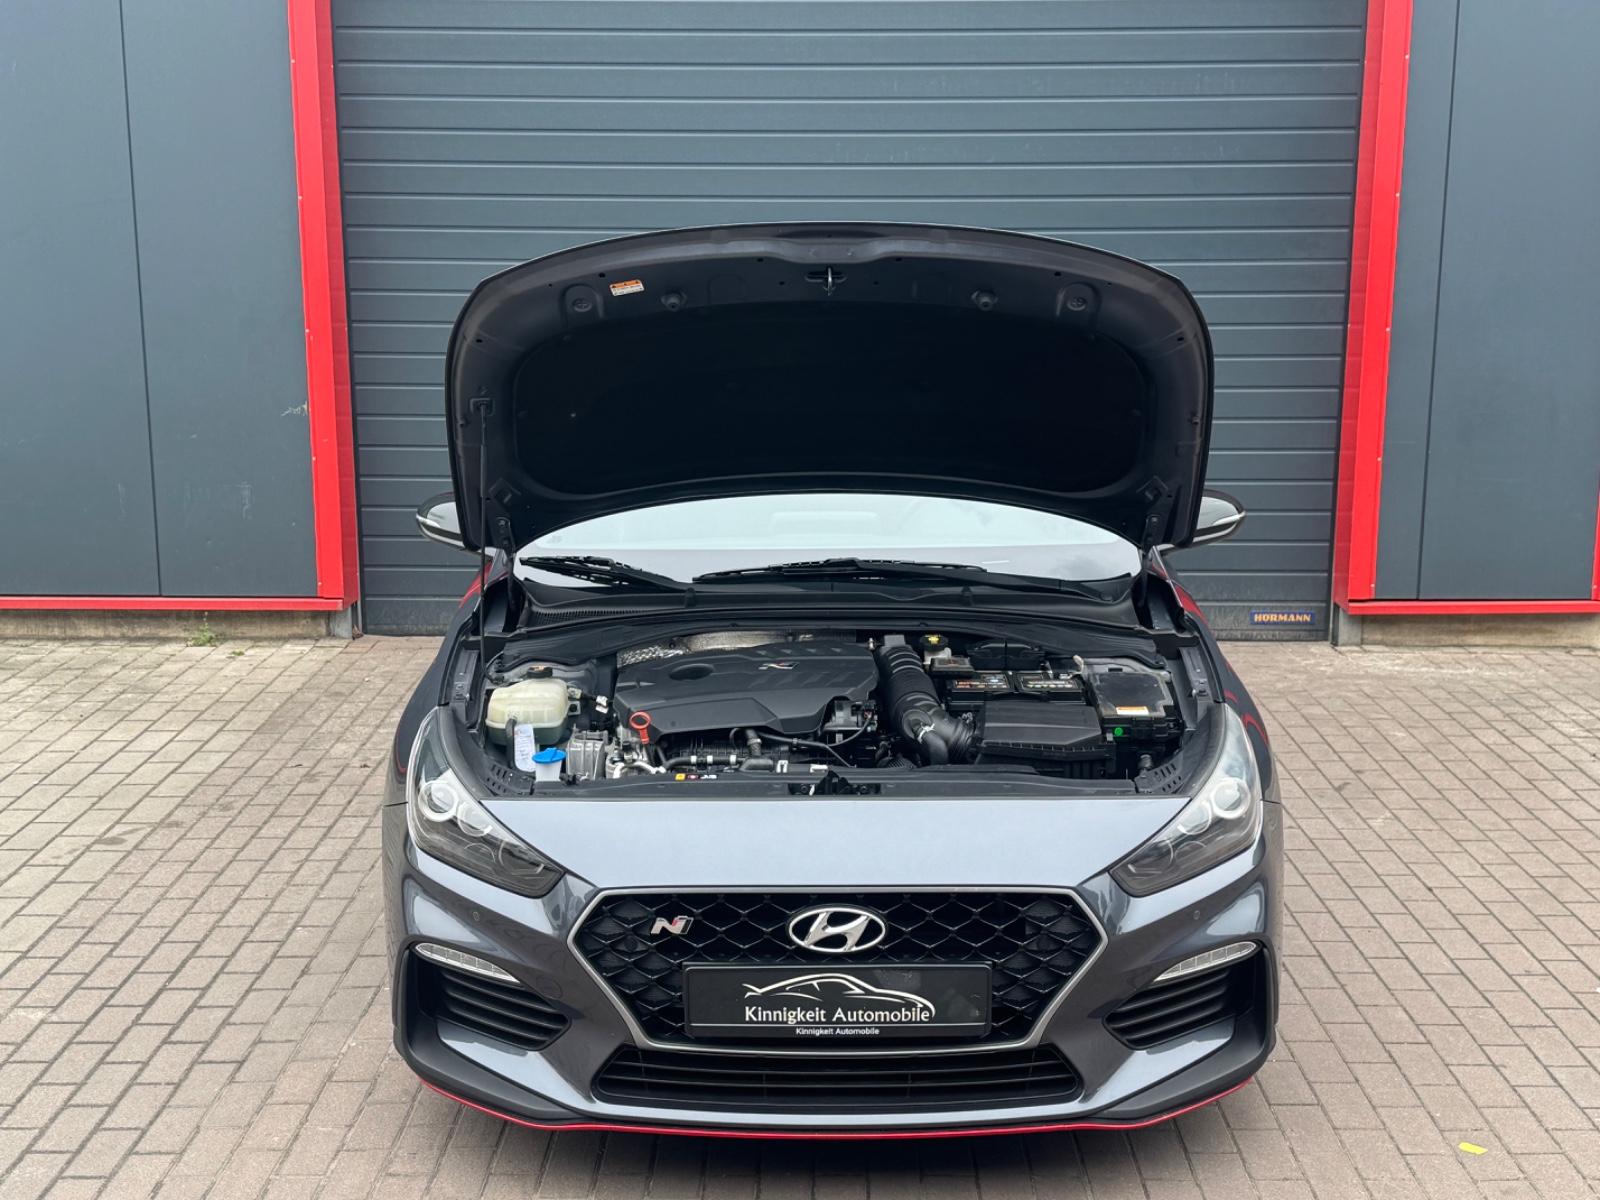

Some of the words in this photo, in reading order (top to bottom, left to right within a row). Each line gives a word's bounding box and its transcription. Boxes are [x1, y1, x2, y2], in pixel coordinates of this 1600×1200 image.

[744, 1006, 827, 1024] Kinnigkeit
[832, 1006, 930, 1022] Automobile
[795, 1028, 834, 1037] Kinnigkeit
